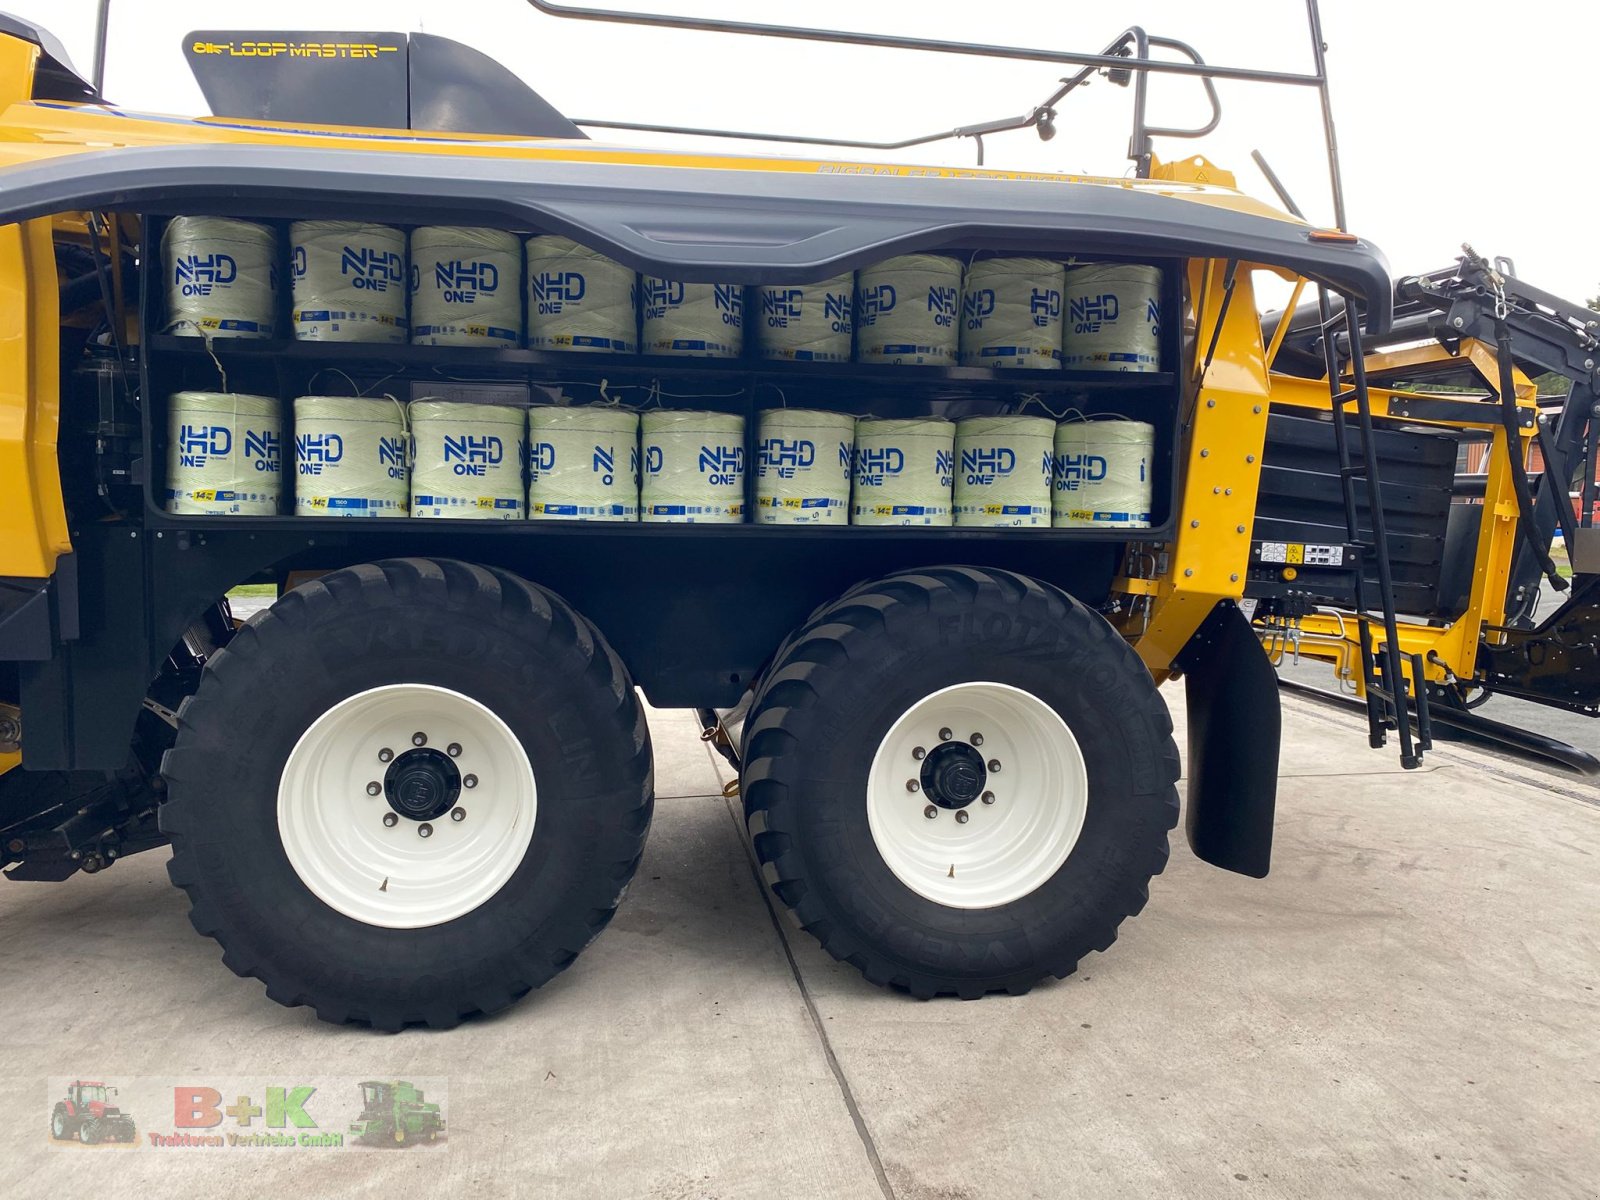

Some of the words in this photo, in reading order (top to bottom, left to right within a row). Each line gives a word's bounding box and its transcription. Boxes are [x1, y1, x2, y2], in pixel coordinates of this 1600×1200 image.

[175, 253, 237, 286] NHD
[341, 246, 403, 282] NHD
[352, 277, 387, 292] ONE
[435, 260, 499, 291] NHD
[182, 283, 213, 296] ONE
[532, 272, 586, 301] NHD
[444, 290, 477, 304] ONE
[714, 283, 744, 316] NH
[762, 289, 804, 317] NHD
[825, 292, 851, 320] NH
[928, 286, 958, 317] NHD
[538, 301, 563, 315] ONE
[646, 306, 667, 319] ONE
[1070, 294, 1119, 324] NHD
[768, 316, 788, 328] ONE
[935, 313, 951, 327] ONE
[1074, 321, 1101, 334] ONE
[245, 430, 280, 459] NH
[296, 433, 344, 463] NHD
[379, 436, 405, 466] NH
[444, 435, 503, 464] NHD
[255, 459, 280, 472] ONE
[299, 463, 323, 475] ONE
[699, 445, 744, 473] NHD
[961, 448, 1016, 474] NHD
[453, 463, 487, 476] ONE
[709, 474, 736, 486] ONE
[859, 474, 883, 486] ONE
[967, 474, 995, 486] ONE
[1056, 480, 1079, 491] ONE
